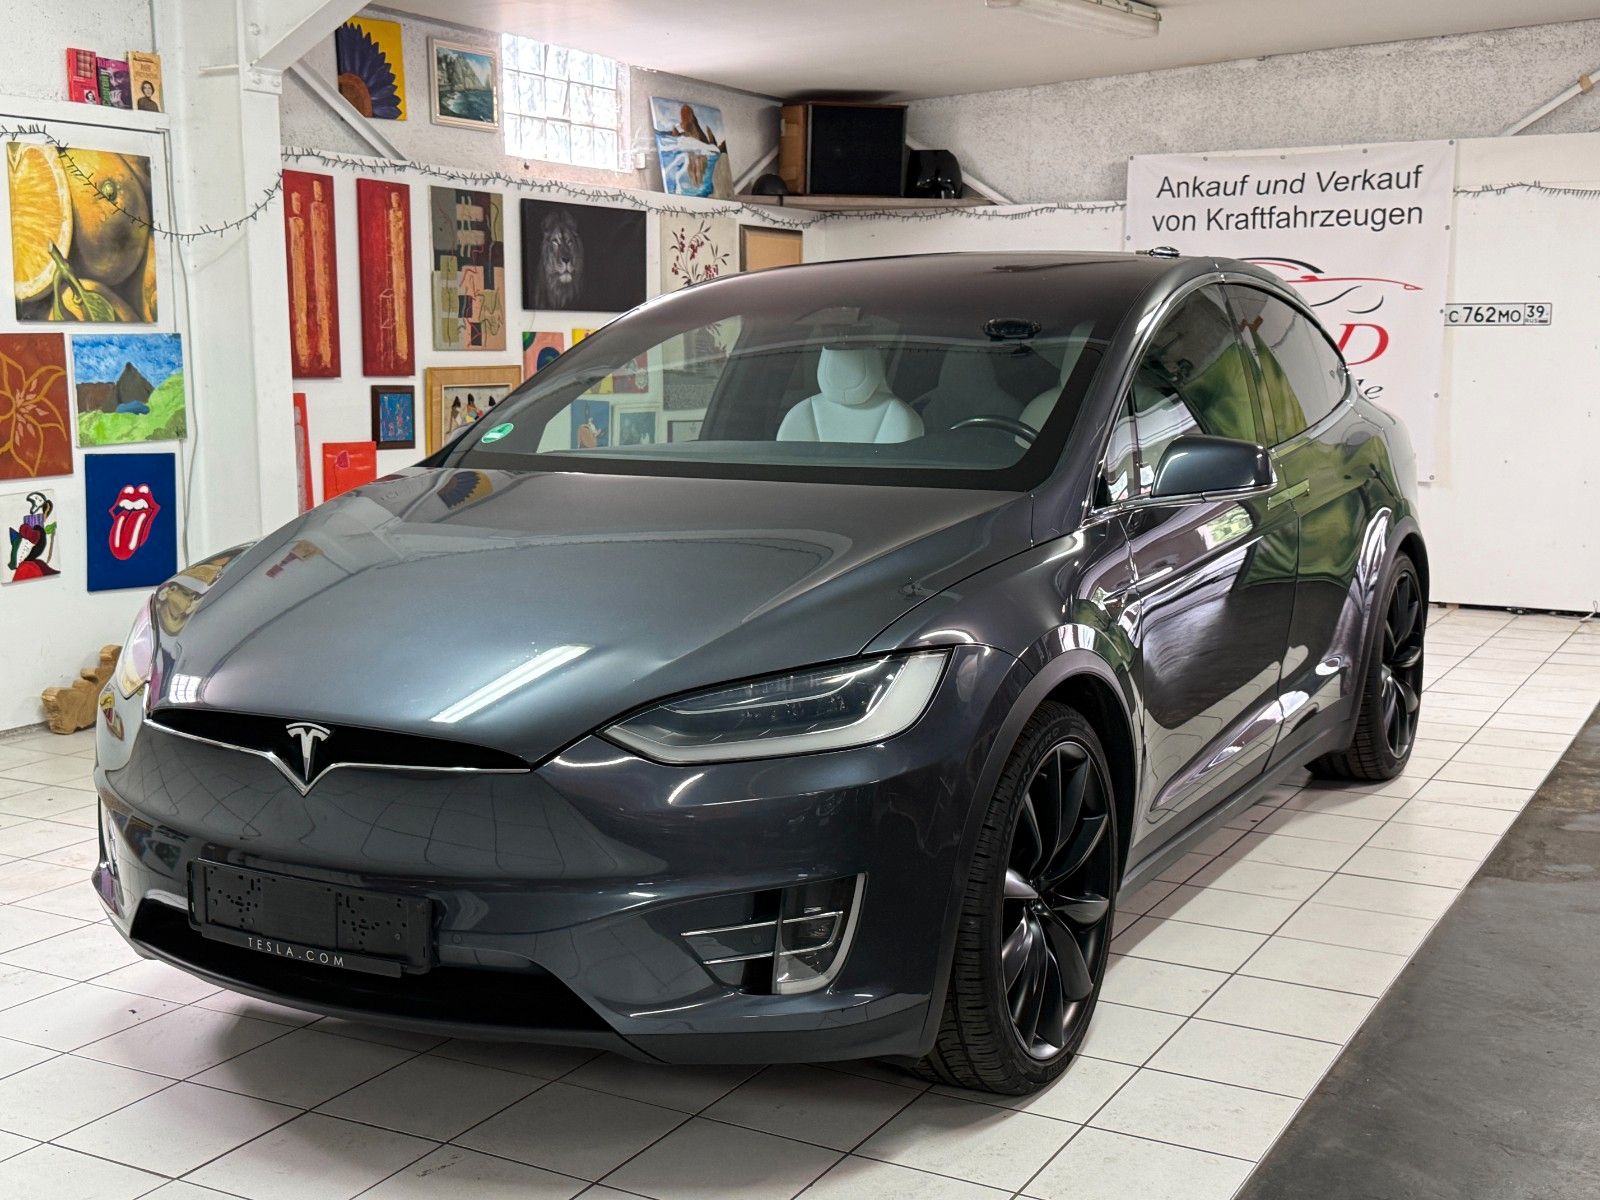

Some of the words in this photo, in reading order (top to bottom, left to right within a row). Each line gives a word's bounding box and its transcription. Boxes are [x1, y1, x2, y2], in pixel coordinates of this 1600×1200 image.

[1156, 175, 1250, 198] Ankauf
[1256, 173, 1306, 196] und
[1316, 165, 1424, 193] Verkauf
[1152, 214, 1196, 232] von
[1207, 205, 1423, 232] Kraftfahrzeugen
[1526, 305, 1545, 318] 39
[248, 937, 344, 967] TESLA.COM
